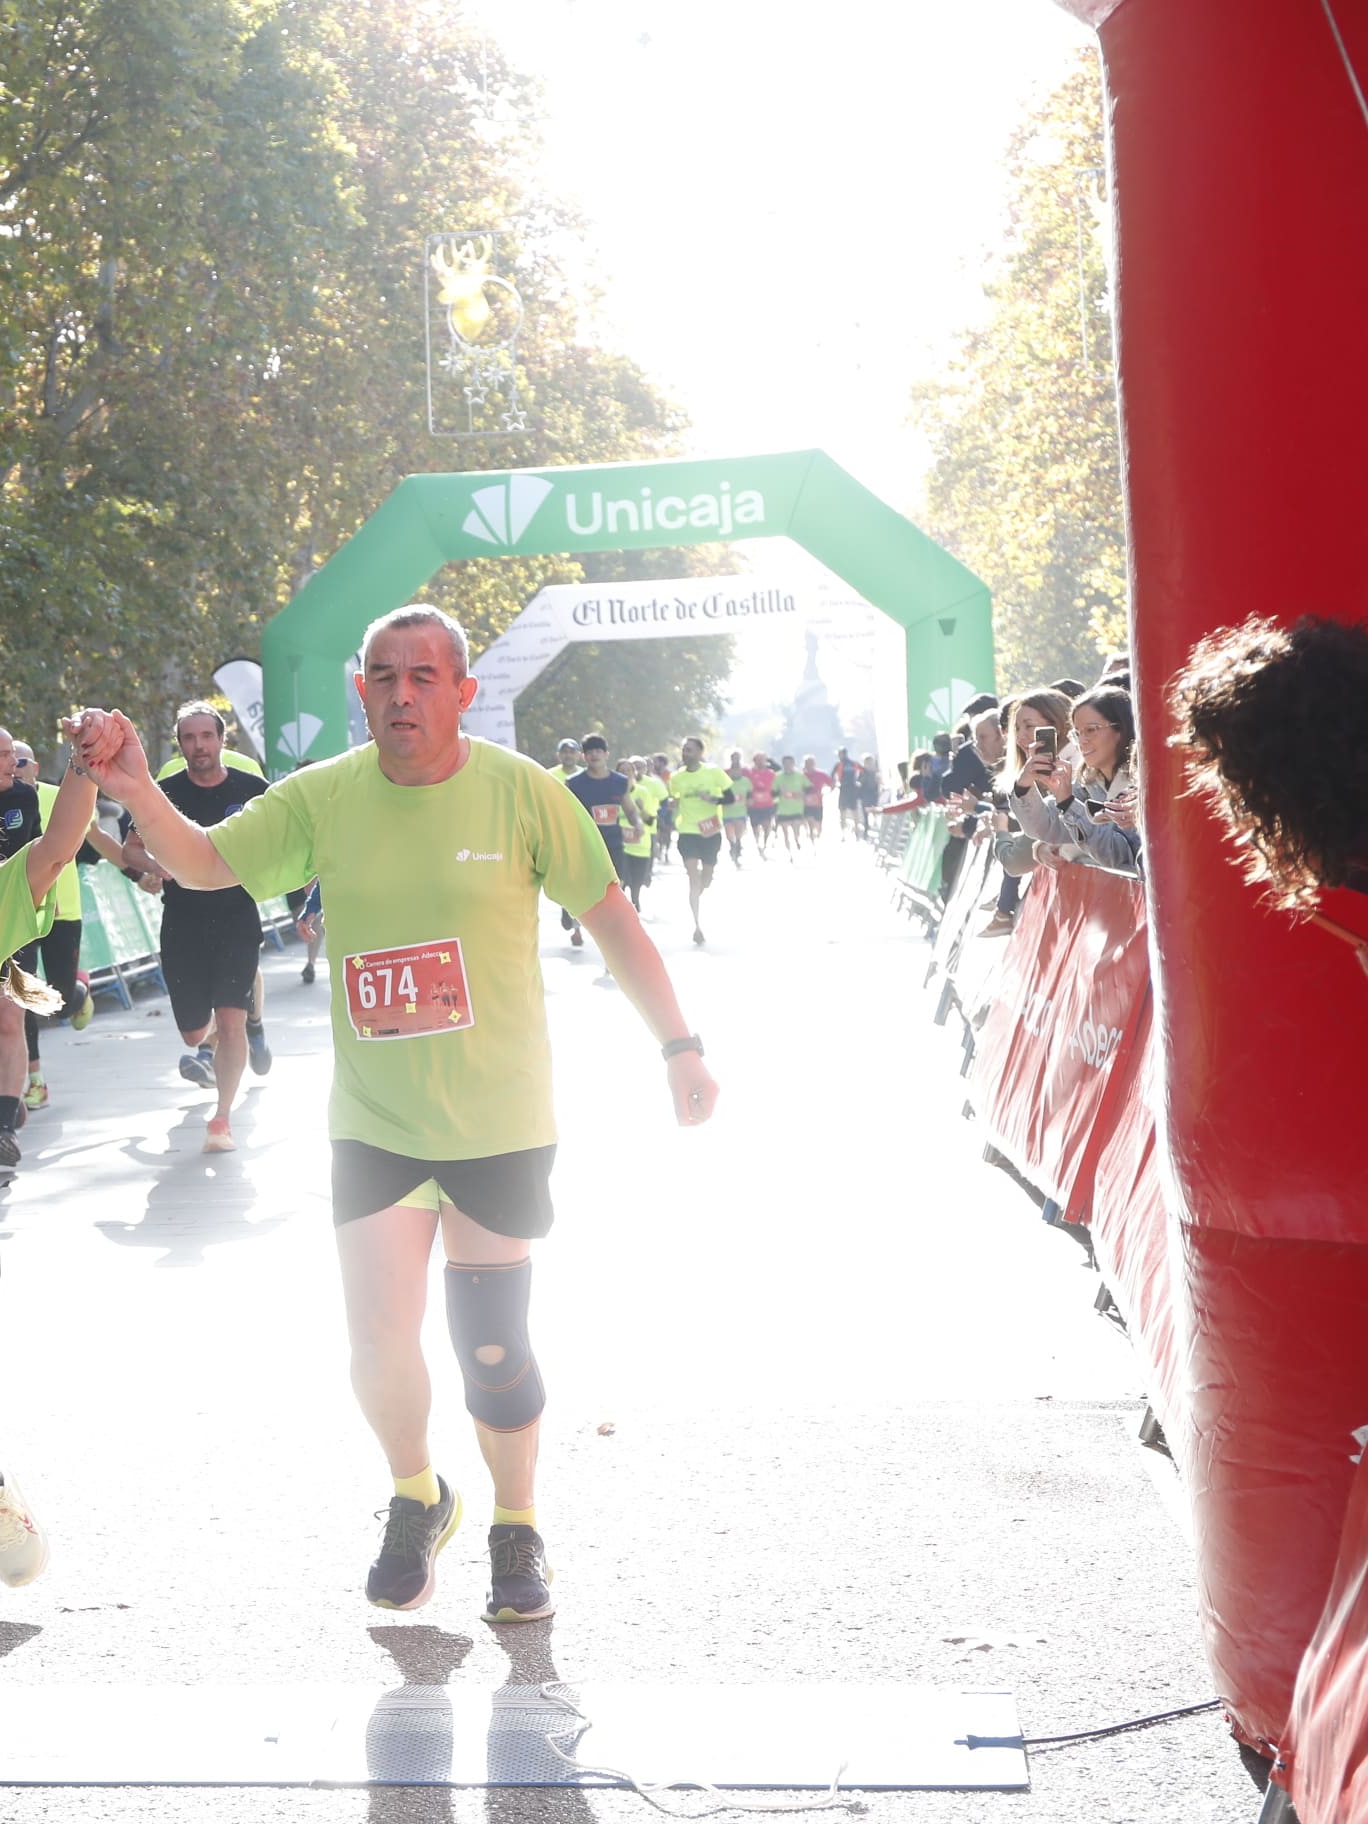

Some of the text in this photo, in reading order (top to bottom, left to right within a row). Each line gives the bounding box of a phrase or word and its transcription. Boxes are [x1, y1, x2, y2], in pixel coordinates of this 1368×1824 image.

[565, 481, 765, 535] Unicaja
[572, 588, 796, 626] El Norte de Castilla
[358, 965, 419, 1009] 674
